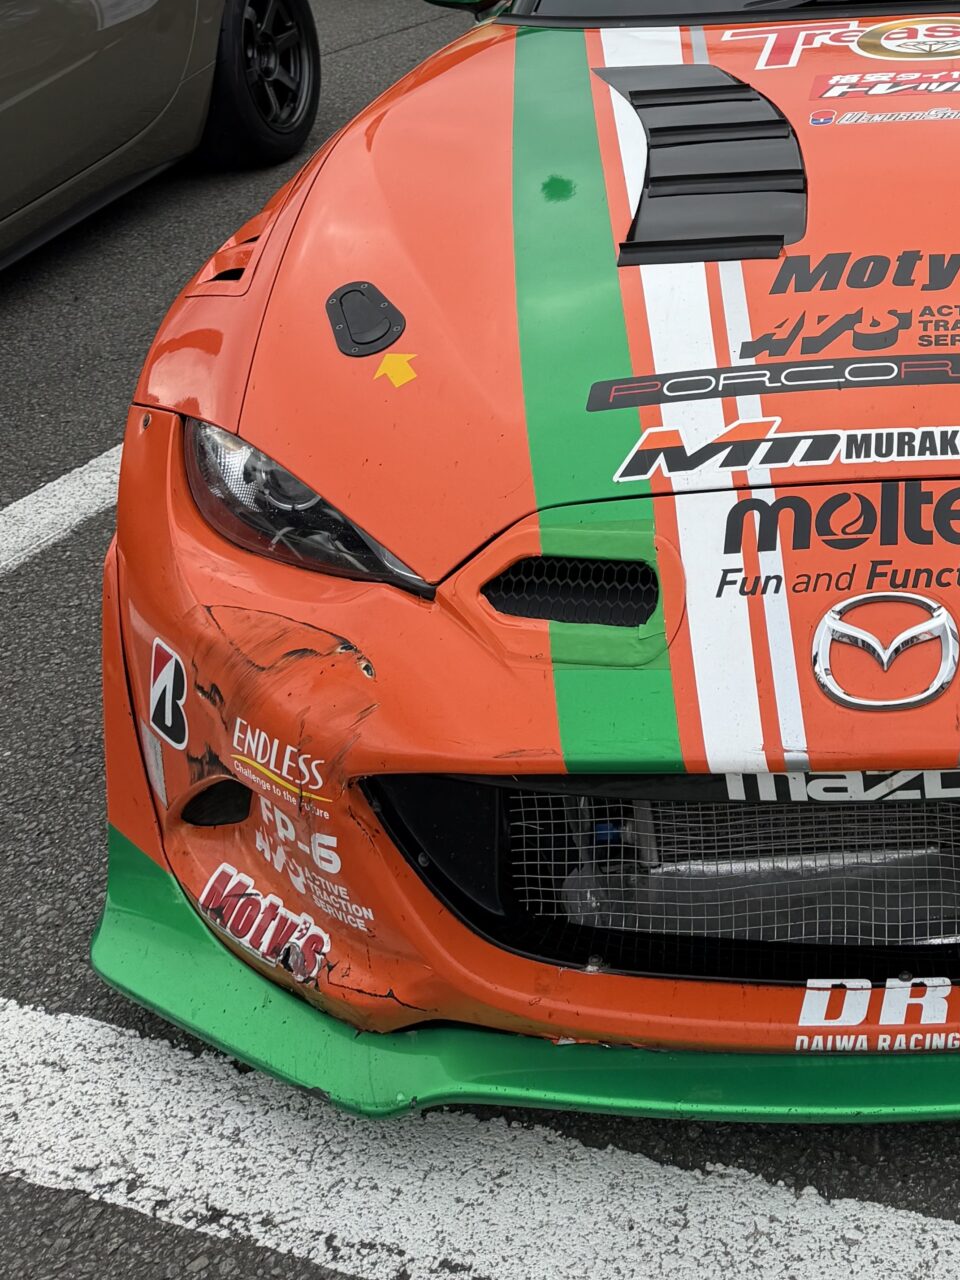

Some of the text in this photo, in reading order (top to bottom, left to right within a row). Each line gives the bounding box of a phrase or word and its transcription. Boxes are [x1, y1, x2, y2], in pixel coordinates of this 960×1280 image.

[715, 568, 783, 599] Fun
[792, 564, 857, 595] and
[232, 716, 326, 790] ENDLESS
[233, 759, 272, 792] Challenge
[273, 782, 283, 797] to
[283, 789, 298, 806] the
[257, 793, 342, 874] FP-6
[304, 869, 350, 901] ACTIVE
[309, 881, 374, 922] TRACTION
[312, 893, 368, 933] SERVICE
[795, 1034, 869, 1051] DAIWA
[877, 1031, 960, 1051] RACING
